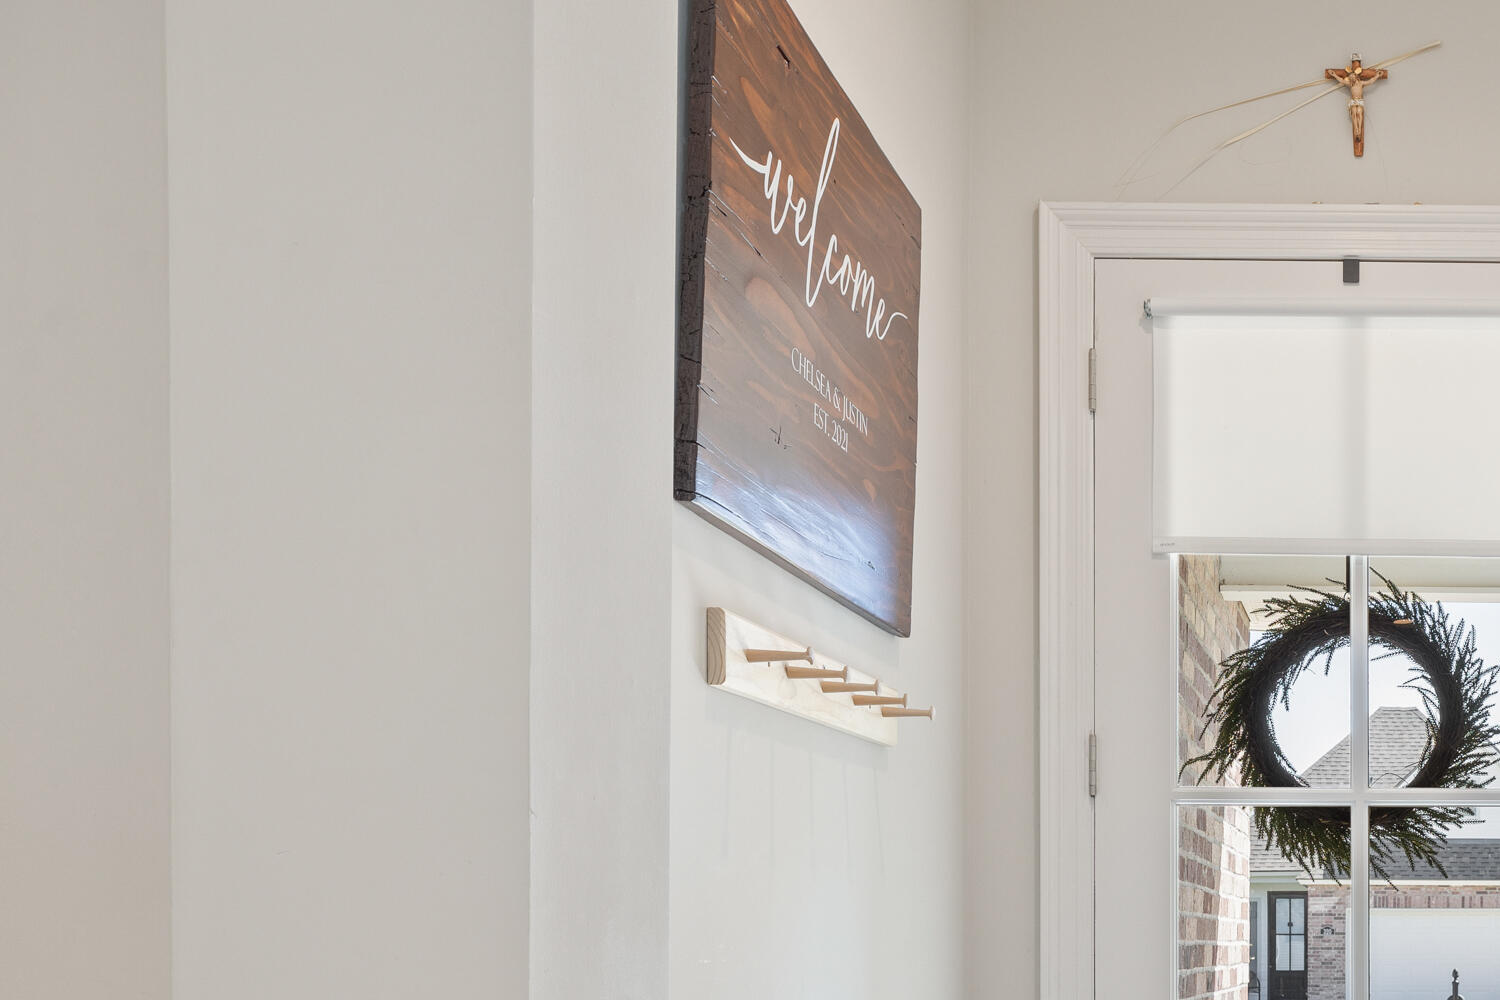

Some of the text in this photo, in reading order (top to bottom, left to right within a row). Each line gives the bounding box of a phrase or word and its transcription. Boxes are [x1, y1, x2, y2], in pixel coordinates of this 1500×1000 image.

[729, 118, 908, 340] welcome
[791, 347, 868, 436] CHELSEA & JUSTIN
[813, 402, 849, 453] EST. 2021
